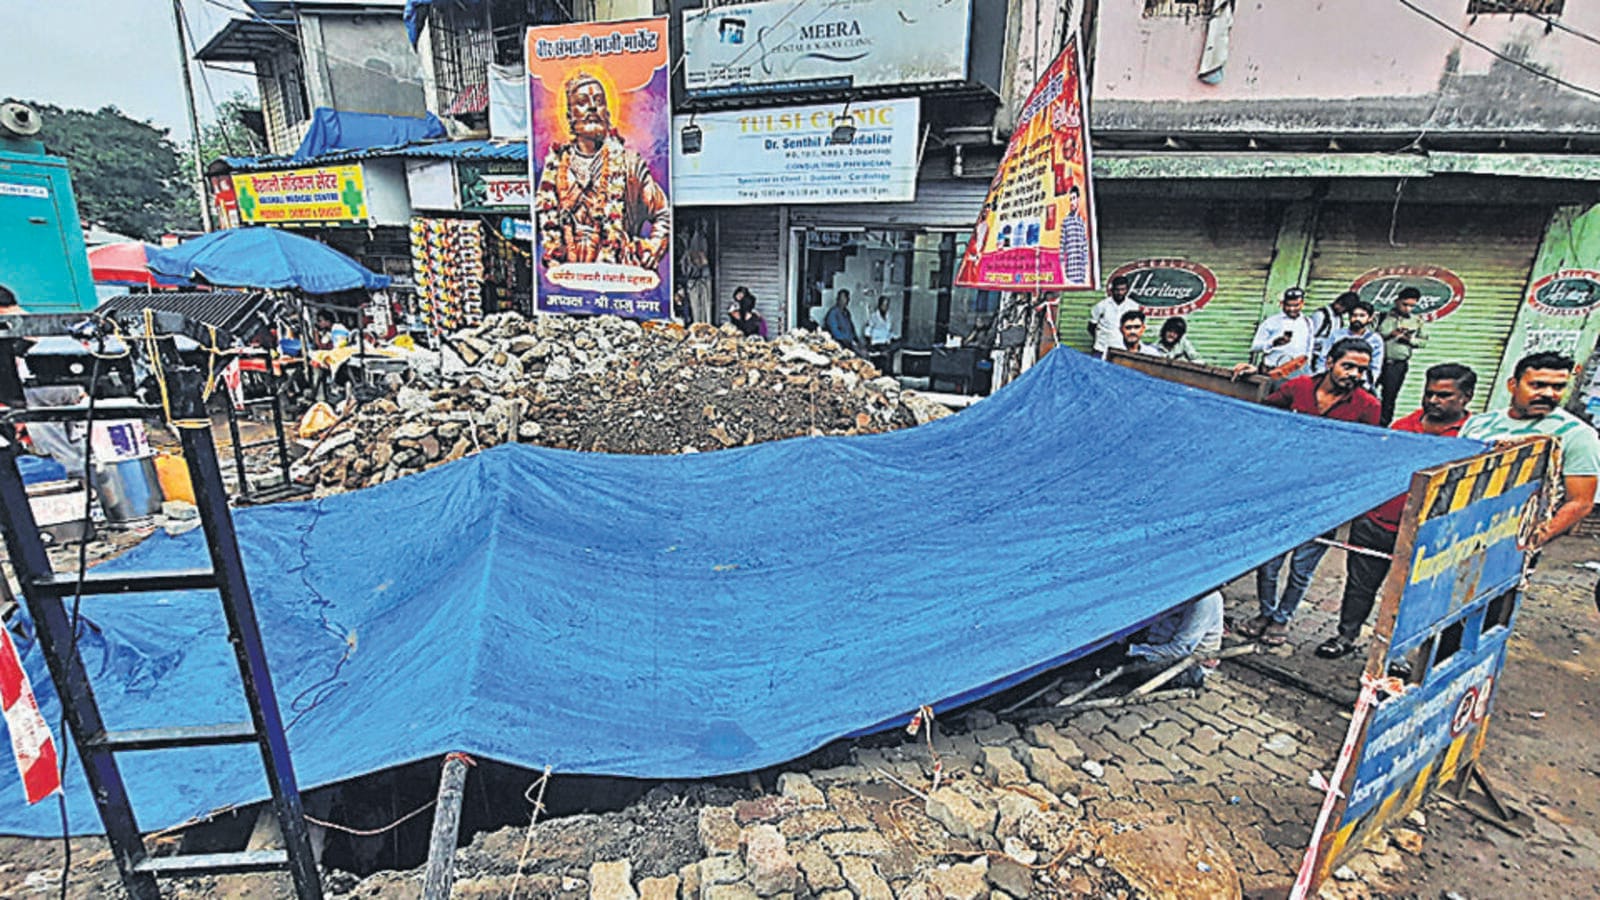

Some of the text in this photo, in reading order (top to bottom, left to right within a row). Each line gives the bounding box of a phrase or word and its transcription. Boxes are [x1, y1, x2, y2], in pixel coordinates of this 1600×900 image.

[800, 20, 860, 40] MEERA
[738, 112, 801, 133] TULSI
[764, 139, 779, 150] Dr.
[783, 135, 821, 150] Senthil
[1126, 272, 1193, 299] Heritage
